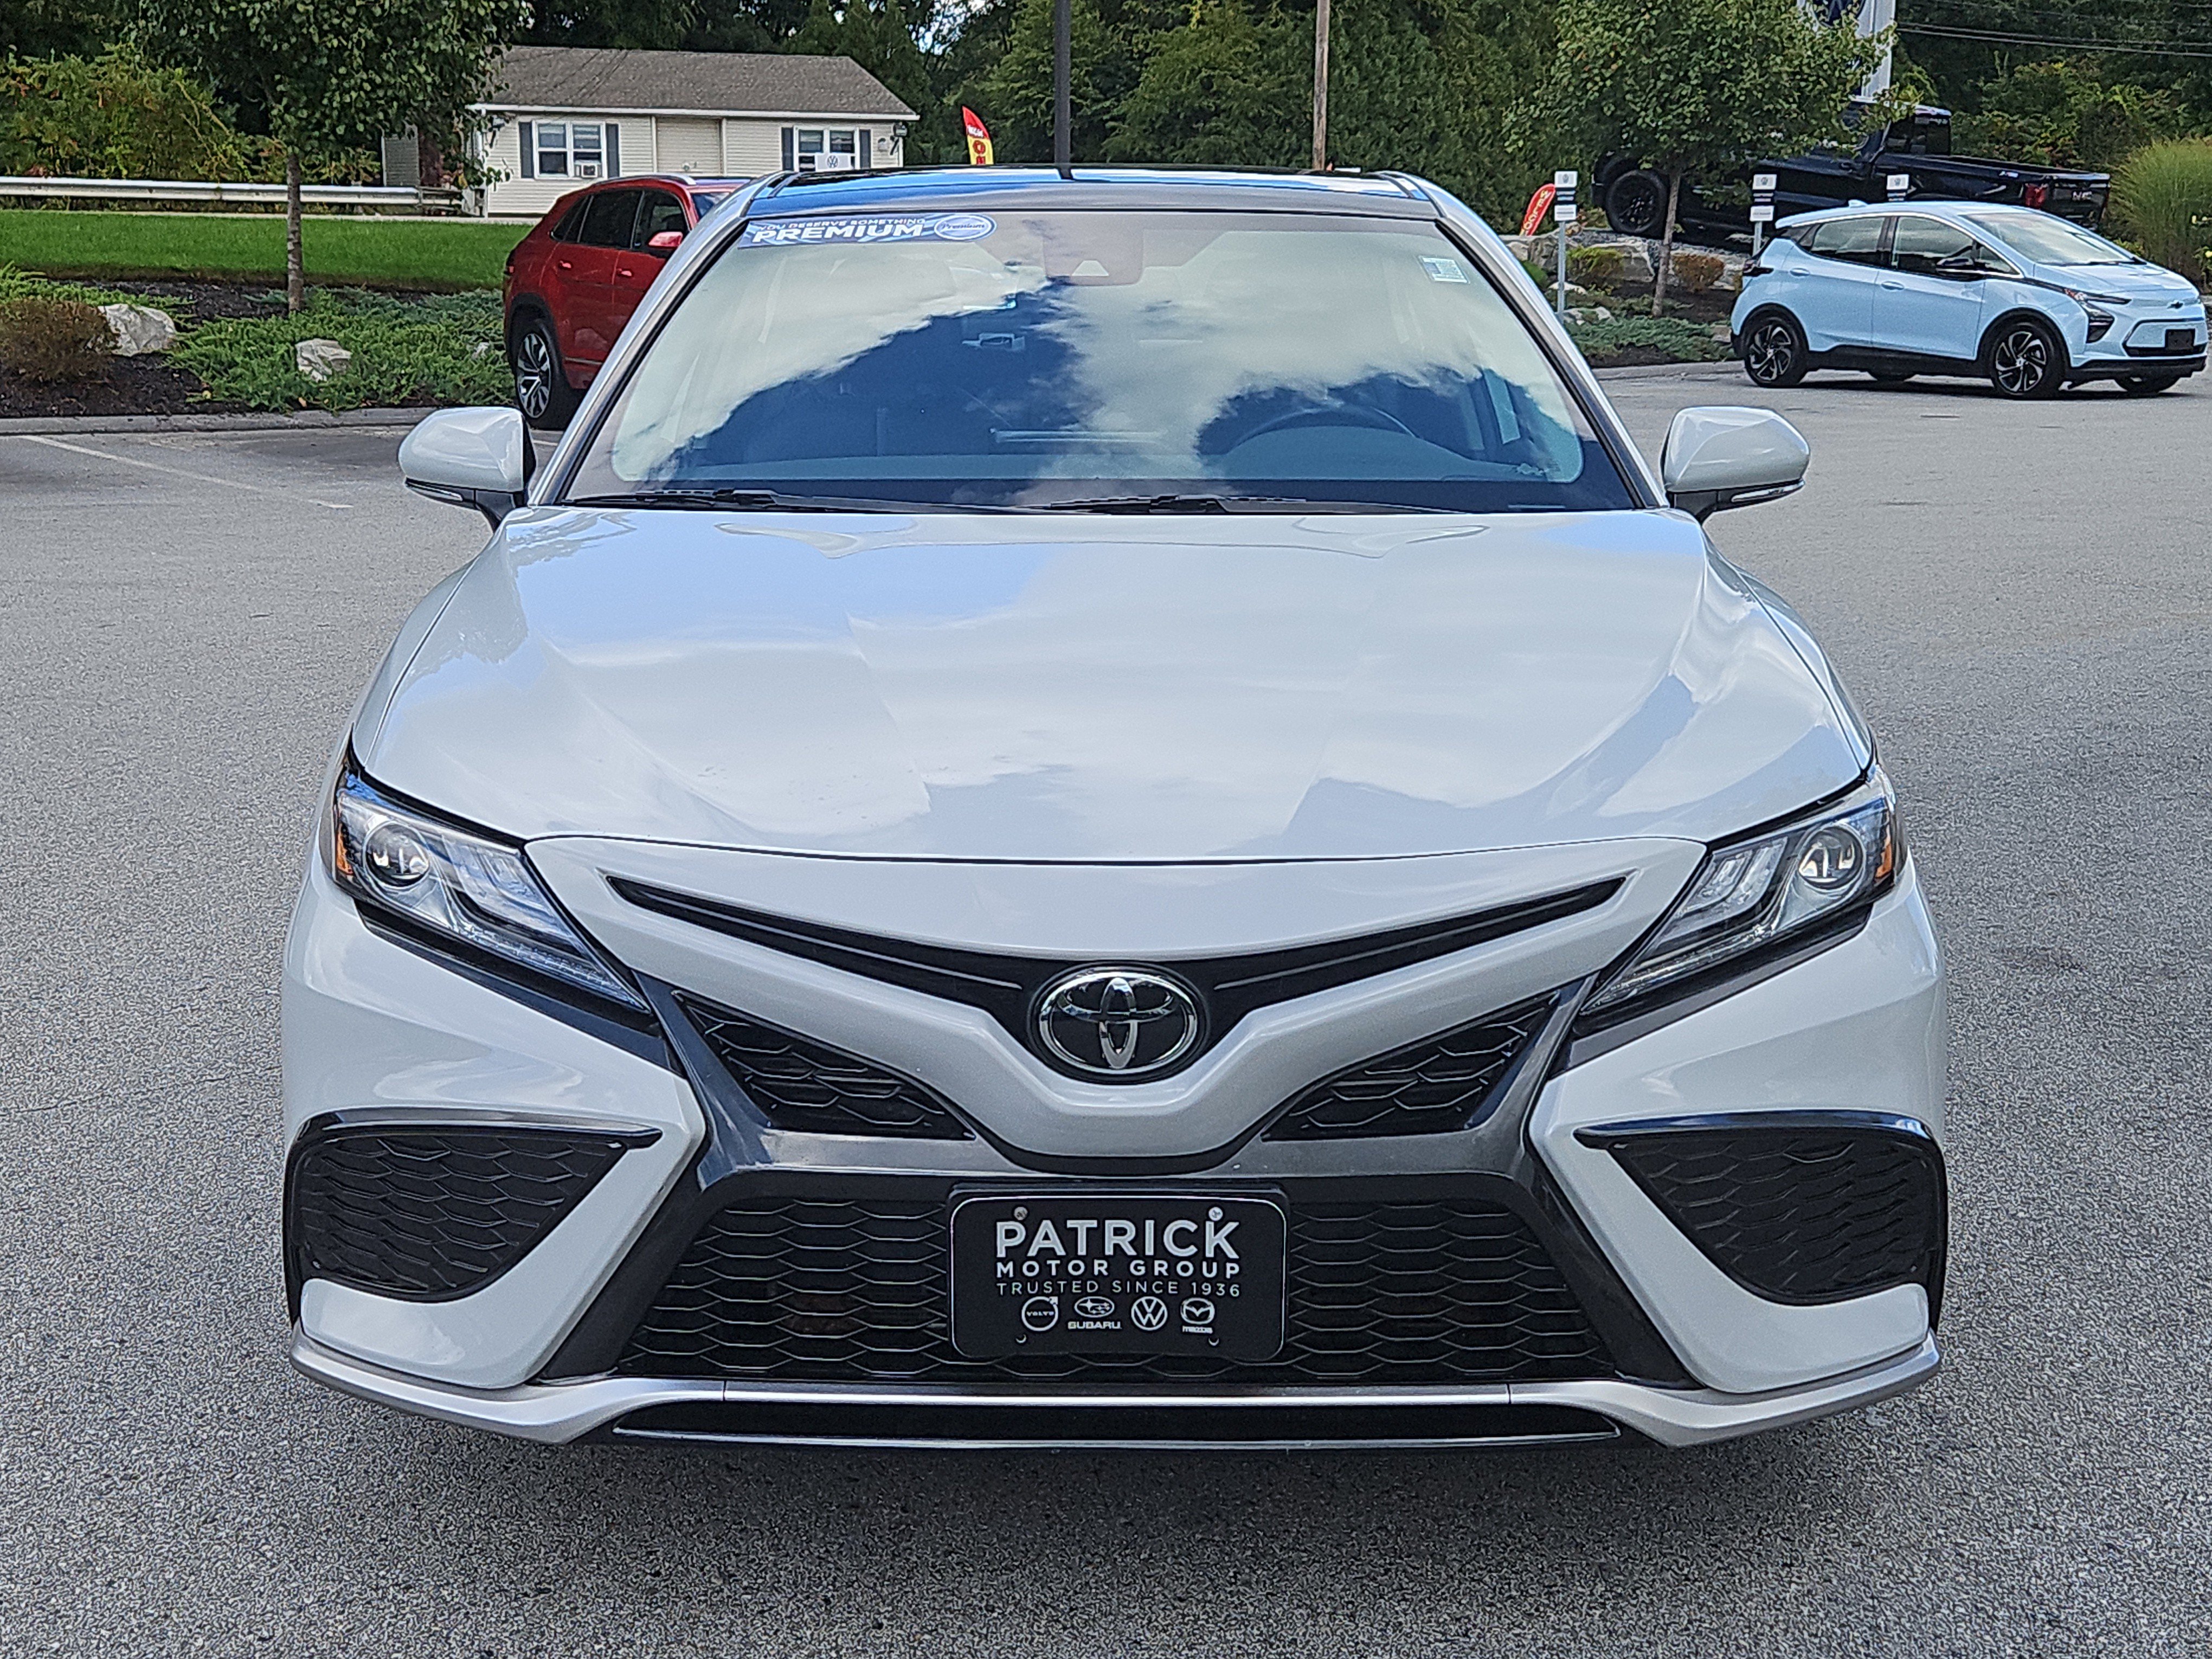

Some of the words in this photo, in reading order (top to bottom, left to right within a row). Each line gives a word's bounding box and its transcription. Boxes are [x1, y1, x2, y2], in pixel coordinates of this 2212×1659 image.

[788, 220, 847, 228] DESERVE
[752, 224, 923, 242] PREMIUM
[996, 1219, 1240, 1259] PATRICK
[996, 1259, 1109, 1278] MOTOR
[1130, 1259, 1240, 1279] GROUP
[996, 1281, 1098, 1295] TRUSTED
[1112, 1281, 1179, 1295] SINCE
[1192, 1282, 1240, 1297] 1936
[1068, 1321, 1121, 1329] SUBARU
